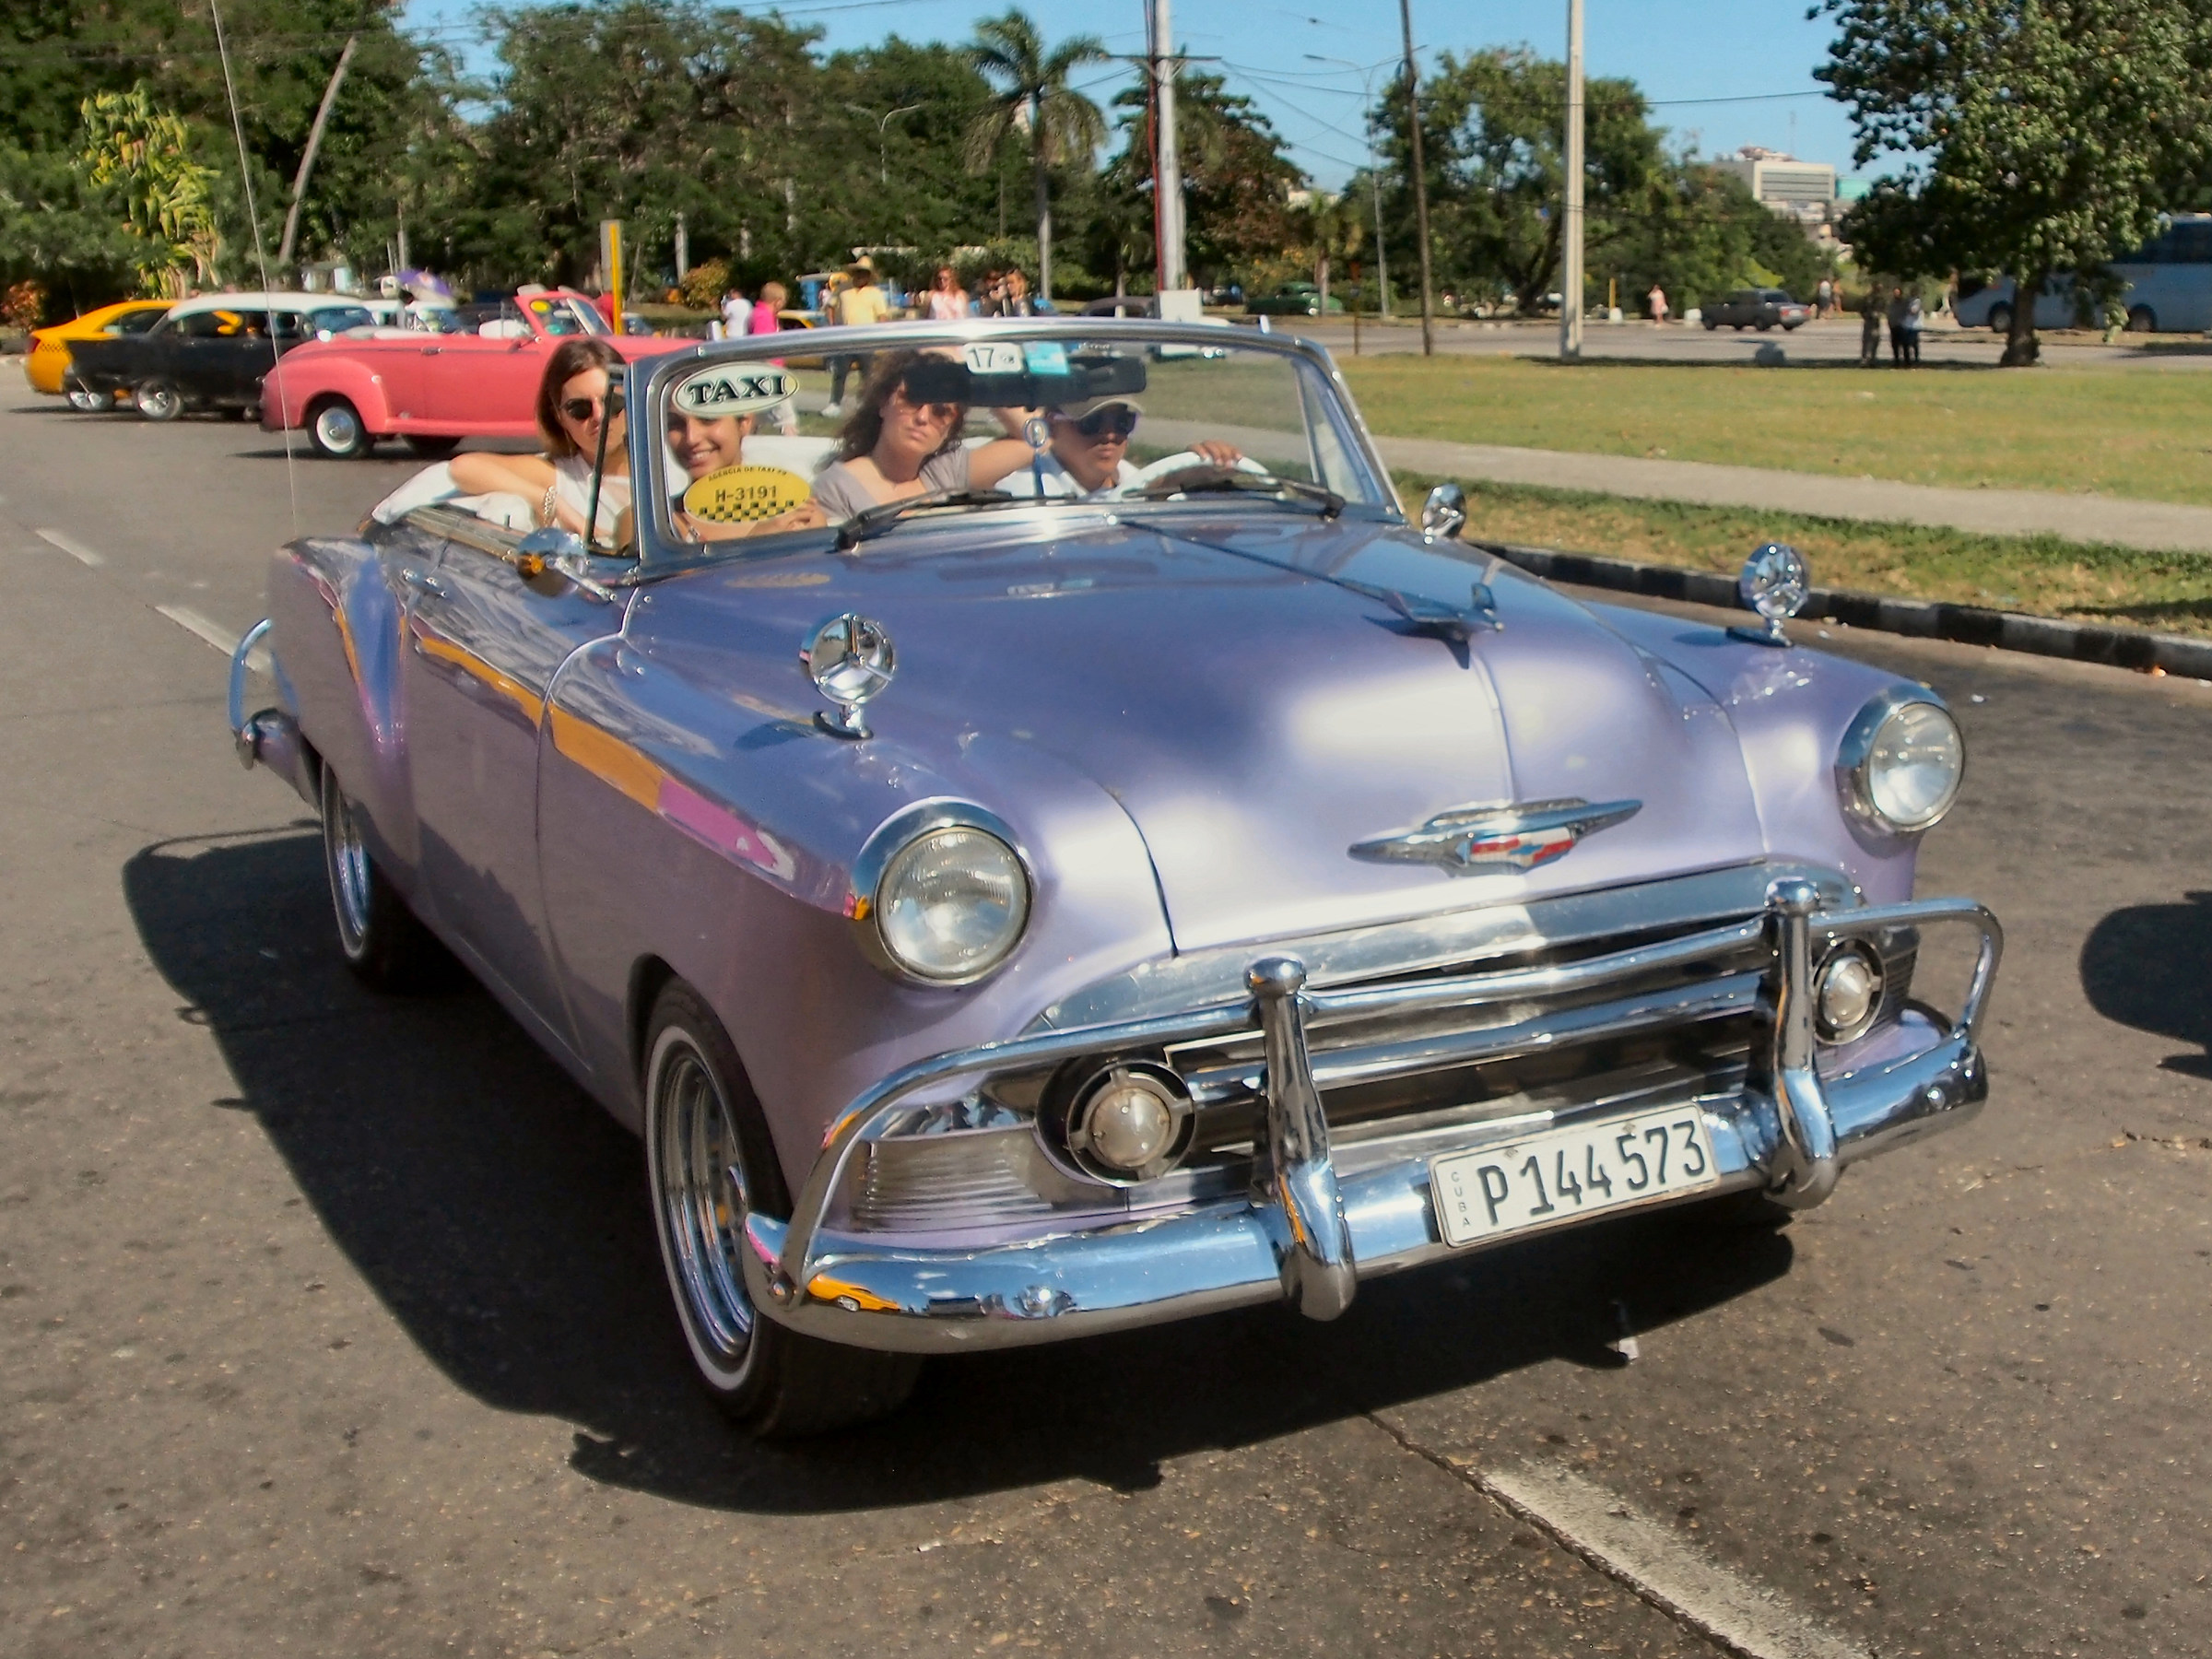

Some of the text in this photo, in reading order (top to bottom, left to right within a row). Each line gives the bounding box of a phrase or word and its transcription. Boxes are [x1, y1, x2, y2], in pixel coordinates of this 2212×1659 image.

[968, 347, 994, 369] 17
[685, 374, 787, 406] TAXI
[708, 466, 741, 482] AGENCIA
[715, 486, 777, 503] H-3191
[1450, 1171, 1472, 1228] CUBA
